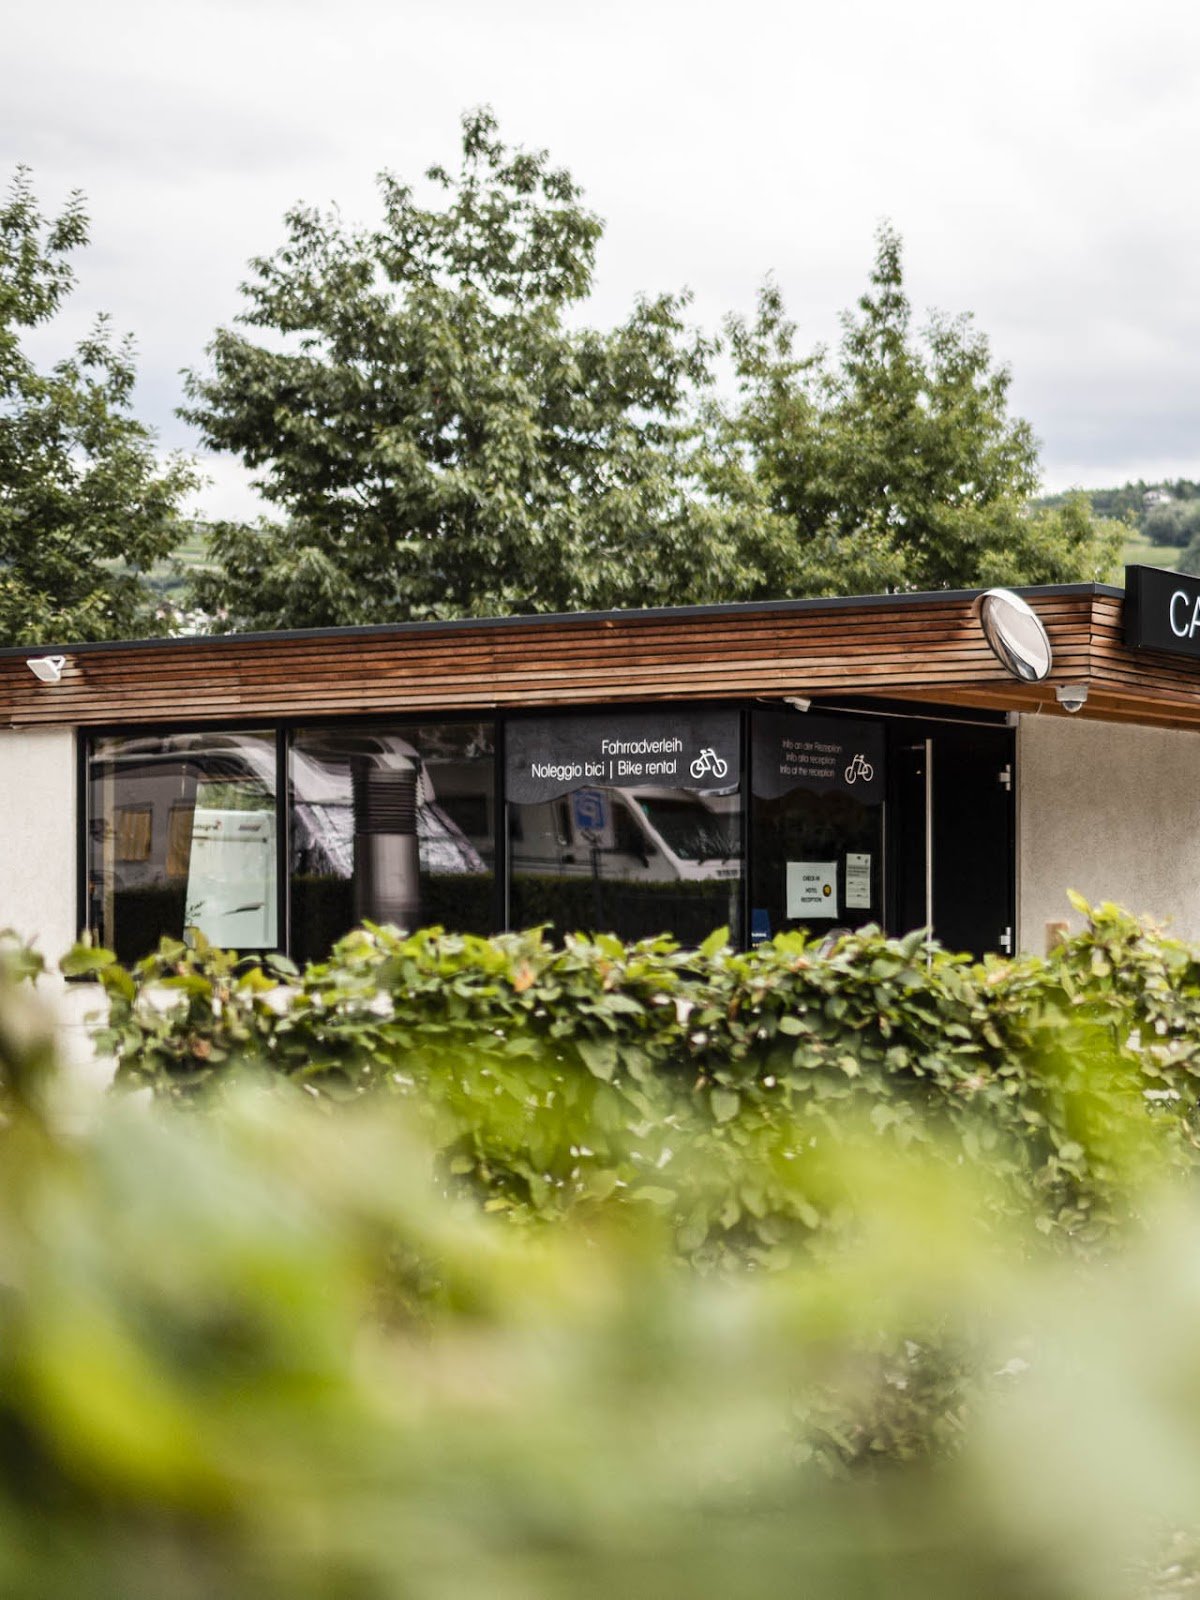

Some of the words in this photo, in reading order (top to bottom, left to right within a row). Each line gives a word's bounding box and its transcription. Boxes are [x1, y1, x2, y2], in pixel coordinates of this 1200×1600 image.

[601, 737, 683, 755] Fahrradverleih
[531, 762, 582, 781] Noleggio
[584, 761, 605, 777] bici
[617, 759, 642, 776] Bike
[645, 759, 677, 775] rental
